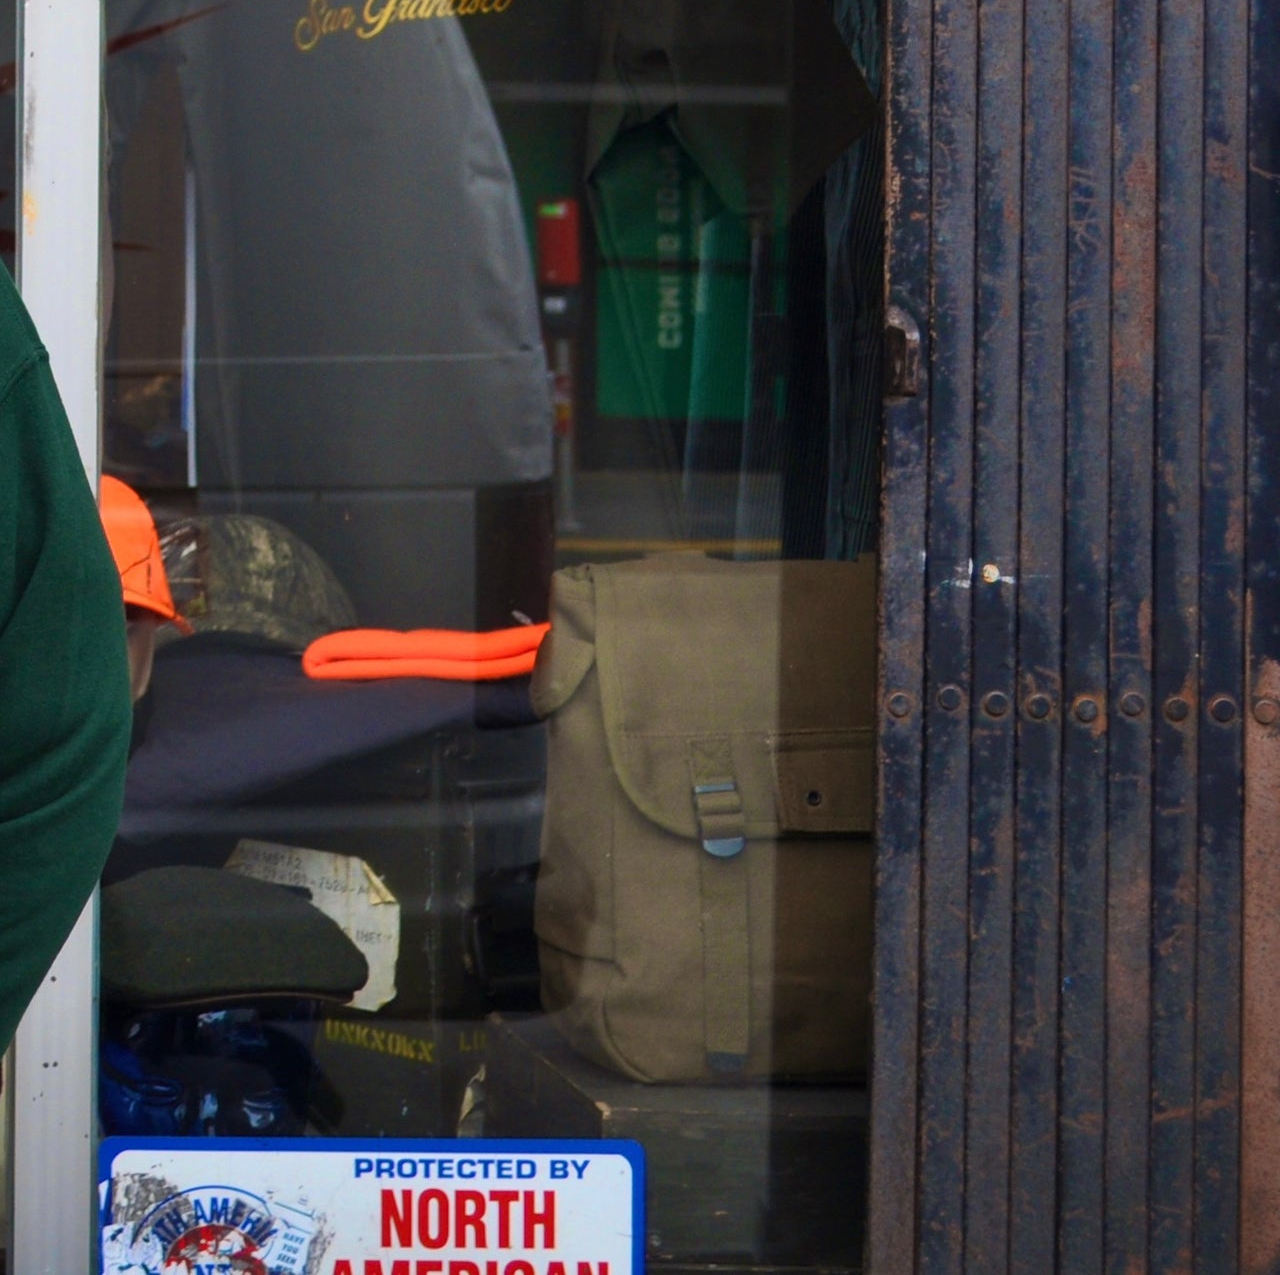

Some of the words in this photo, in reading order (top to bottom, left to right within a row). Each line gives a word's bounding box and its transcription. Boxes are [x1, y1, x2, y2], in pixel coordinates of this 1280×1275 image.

[354, 1157, 538, 1180] PROTECTED
[549, 1159, 591, 1180] BY
[380, 1188, 556, 1250] NORTH
